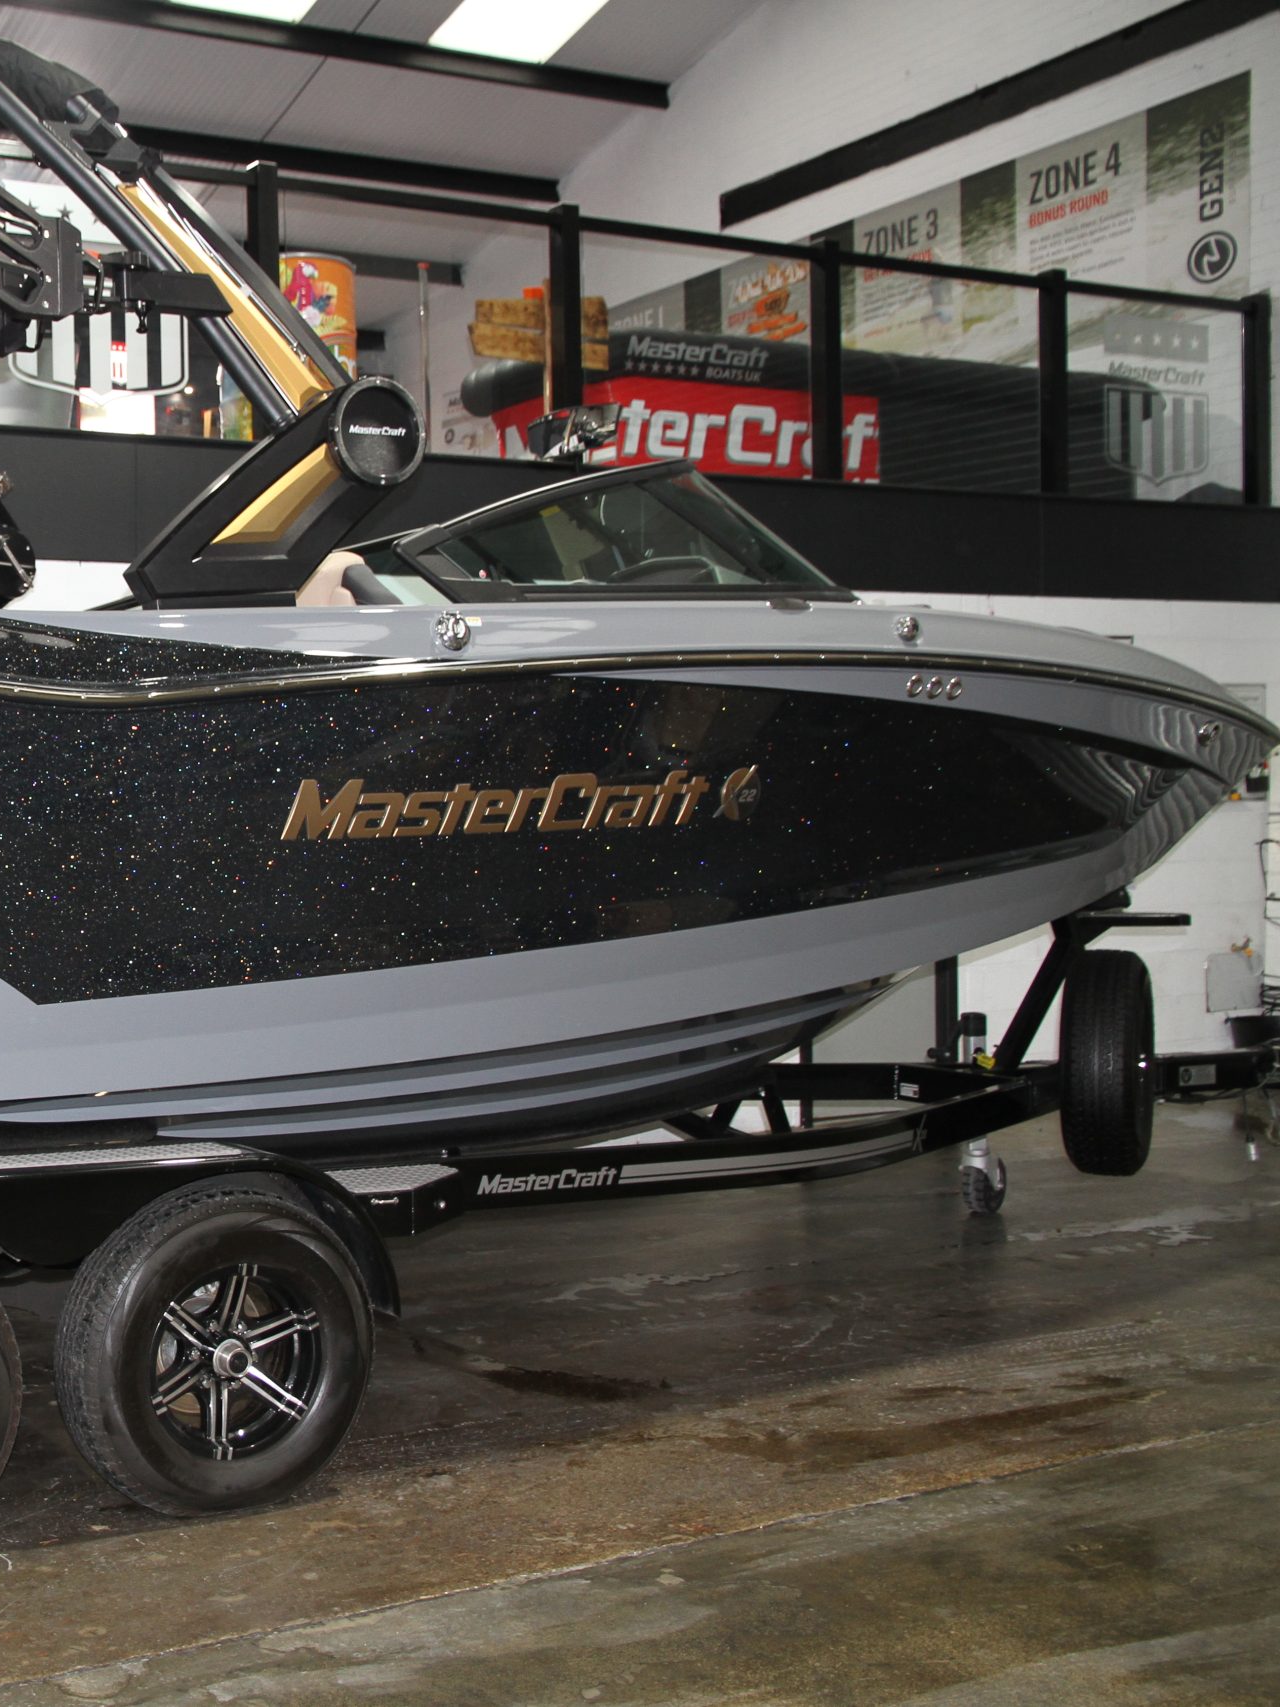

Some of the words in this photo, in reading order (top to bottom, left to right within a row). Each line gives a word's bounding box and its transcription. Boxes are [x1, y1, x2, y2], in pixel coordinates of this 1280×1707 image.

[1029, 150, 1098, 205] ZONE
[1105, 142, 1122, 176] 4
[1028, 203, 1066, 229] BONUS
[1068, 188, 1109, 214] ROUND
[863, 215, 919, 257] ZONE
[926, 208, 939, 241] 3
[626, 334, 769, 369] MasterCraft
[705, 367, 743, 381] BOATS
[744, 370, 762, 383] UK
[1108, 360, 1205, 386] MasterCraft
[349, 424, 407, 437] MasterCraft
[280, 769, 710, 841] MasterCraft
[477, 1166, 617, 1196] MasterCraft
